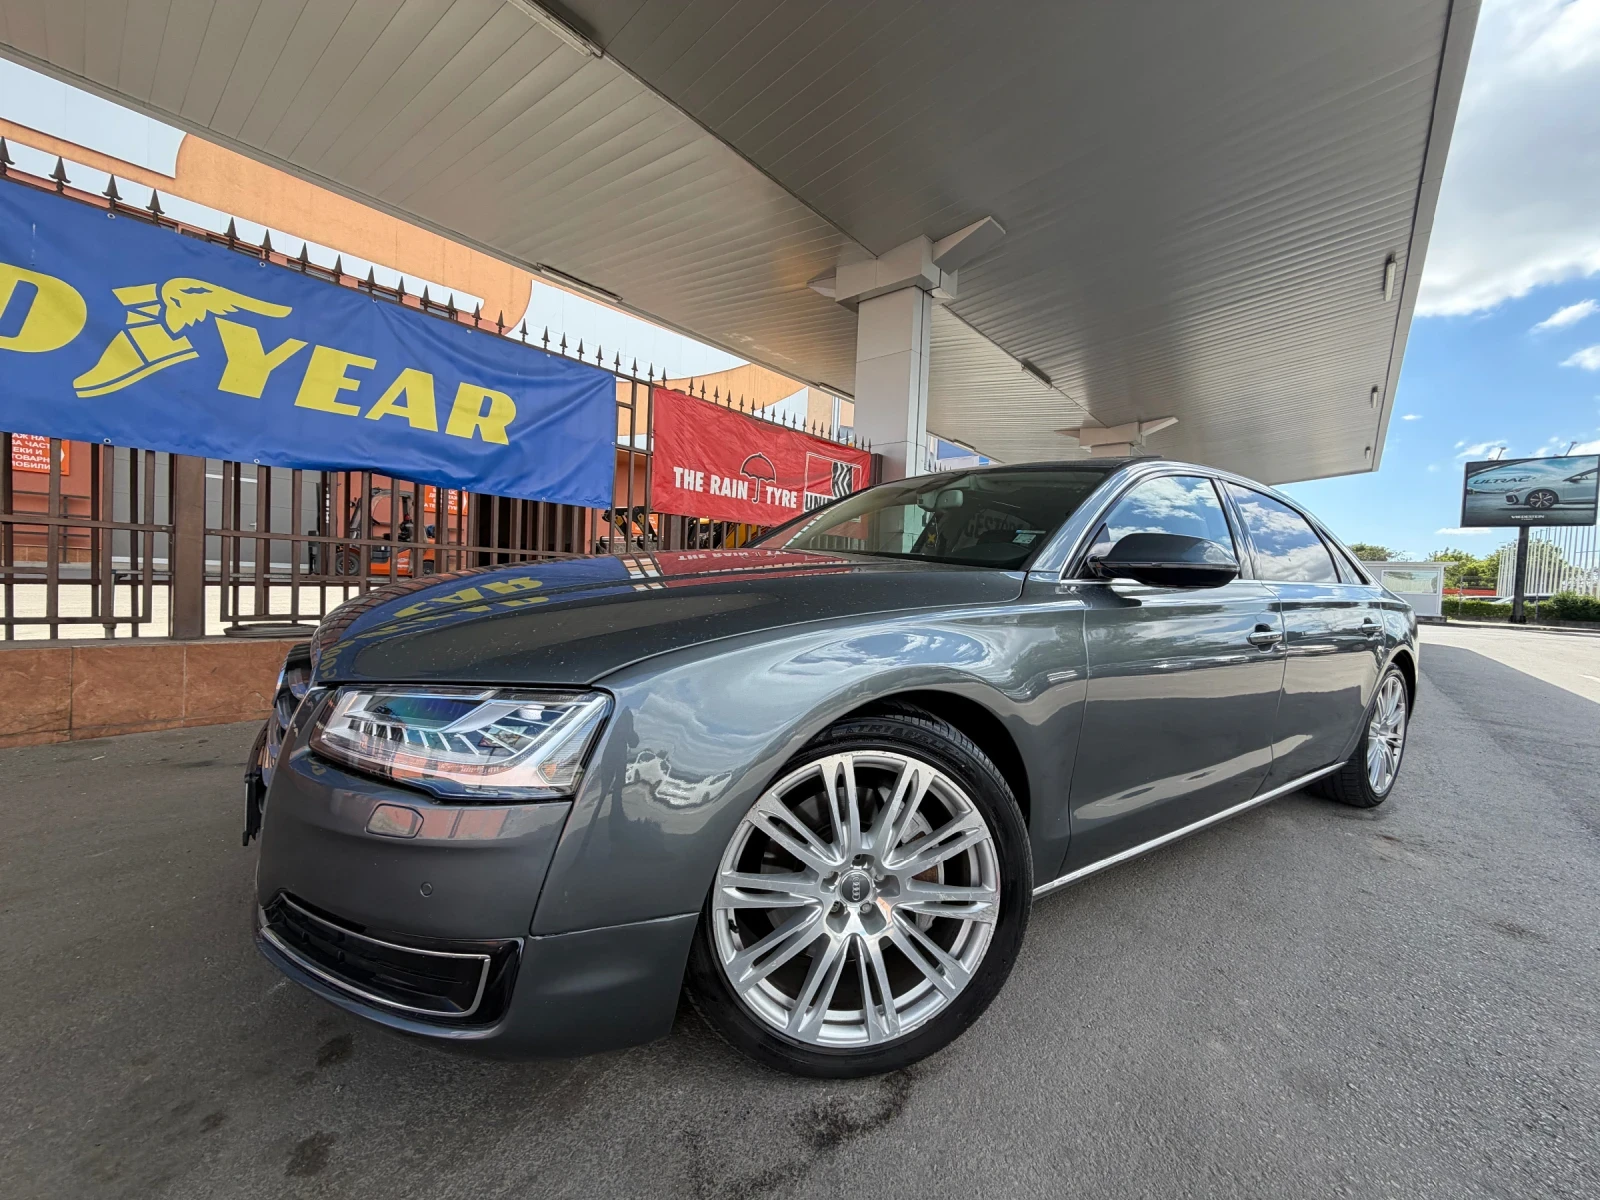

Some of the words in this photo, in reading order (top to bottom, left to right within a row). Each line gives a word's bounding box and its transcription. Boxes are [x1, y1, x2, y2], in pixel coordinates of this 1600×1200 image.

[215, 316, 517, 446] YEAR
[673, 466, 704, 492] THE
[709, 474, 749, 500] RAIN
[766, 486, 798, 508] TYRE
